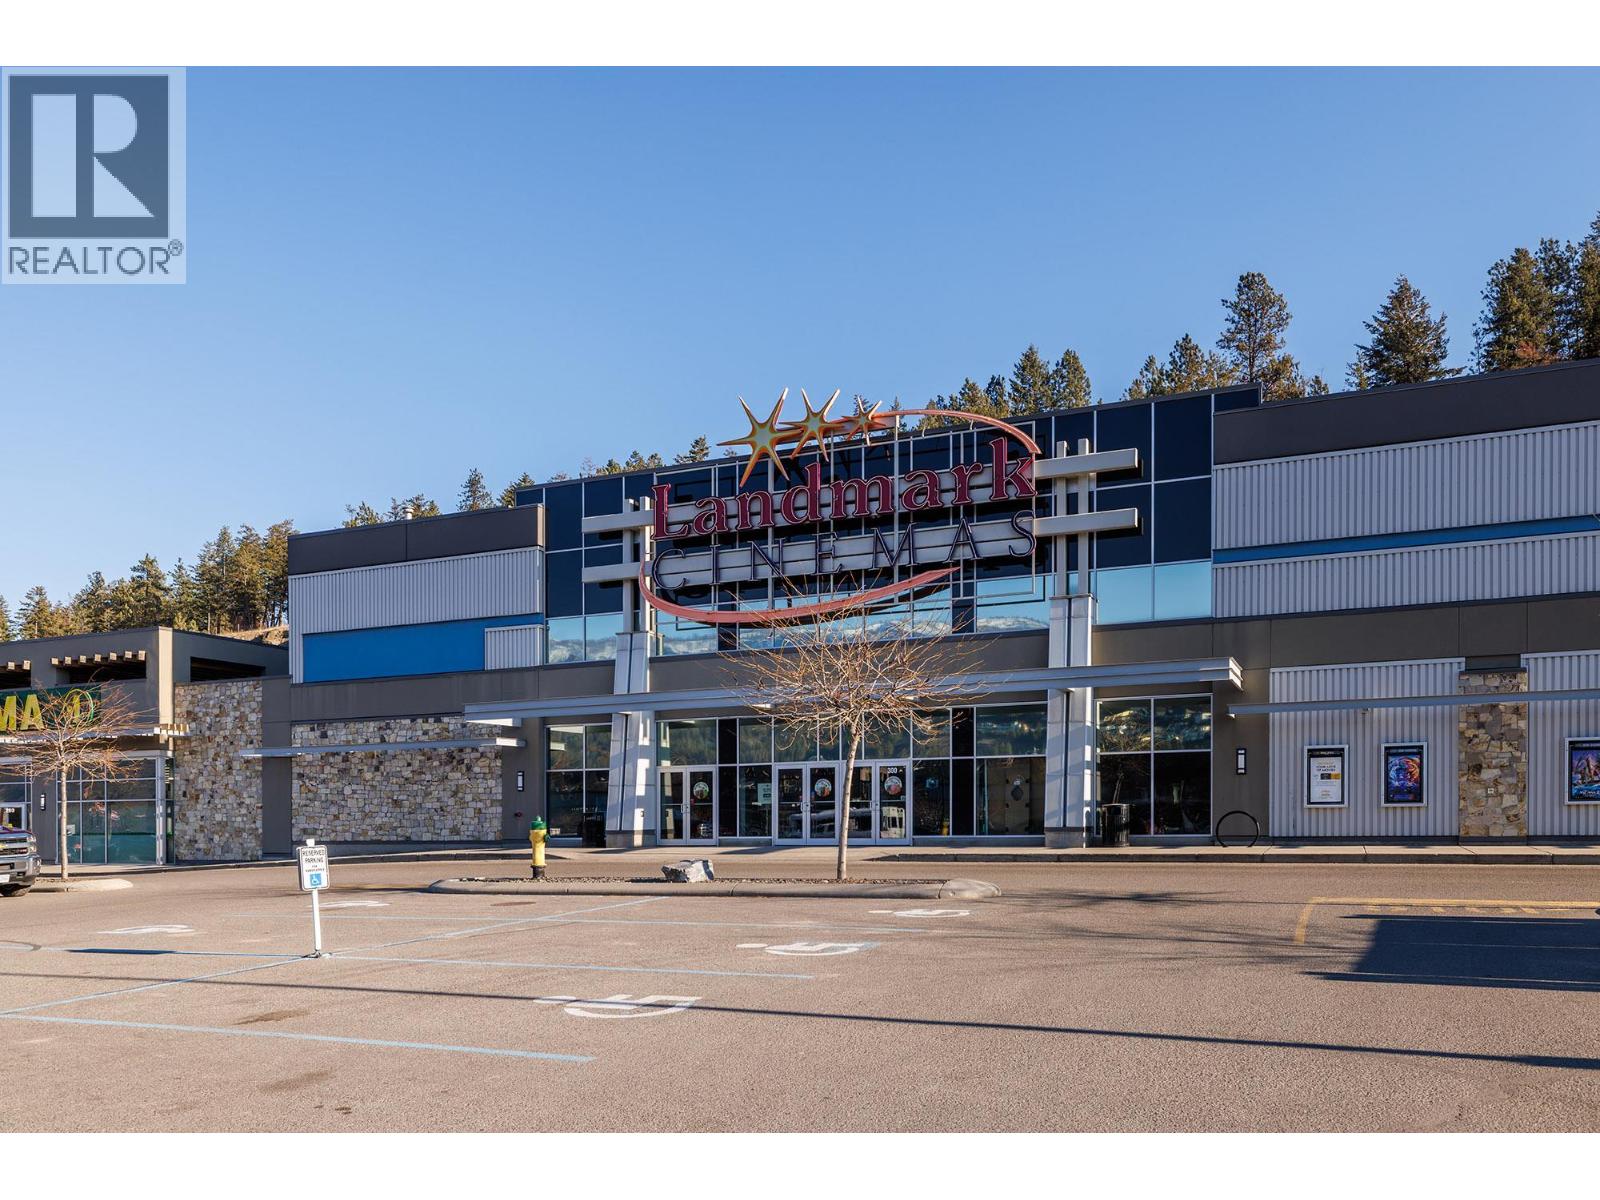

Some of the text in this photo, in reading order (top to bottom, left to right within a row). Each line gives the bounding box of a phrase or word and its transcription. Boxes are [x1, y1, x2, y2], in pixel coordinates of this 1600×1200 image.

[651, 437, 1038, 541] Landmark
[651, 509, 1037, 591] CINEMAS
[302, 849, 325, 857] RESERVED
